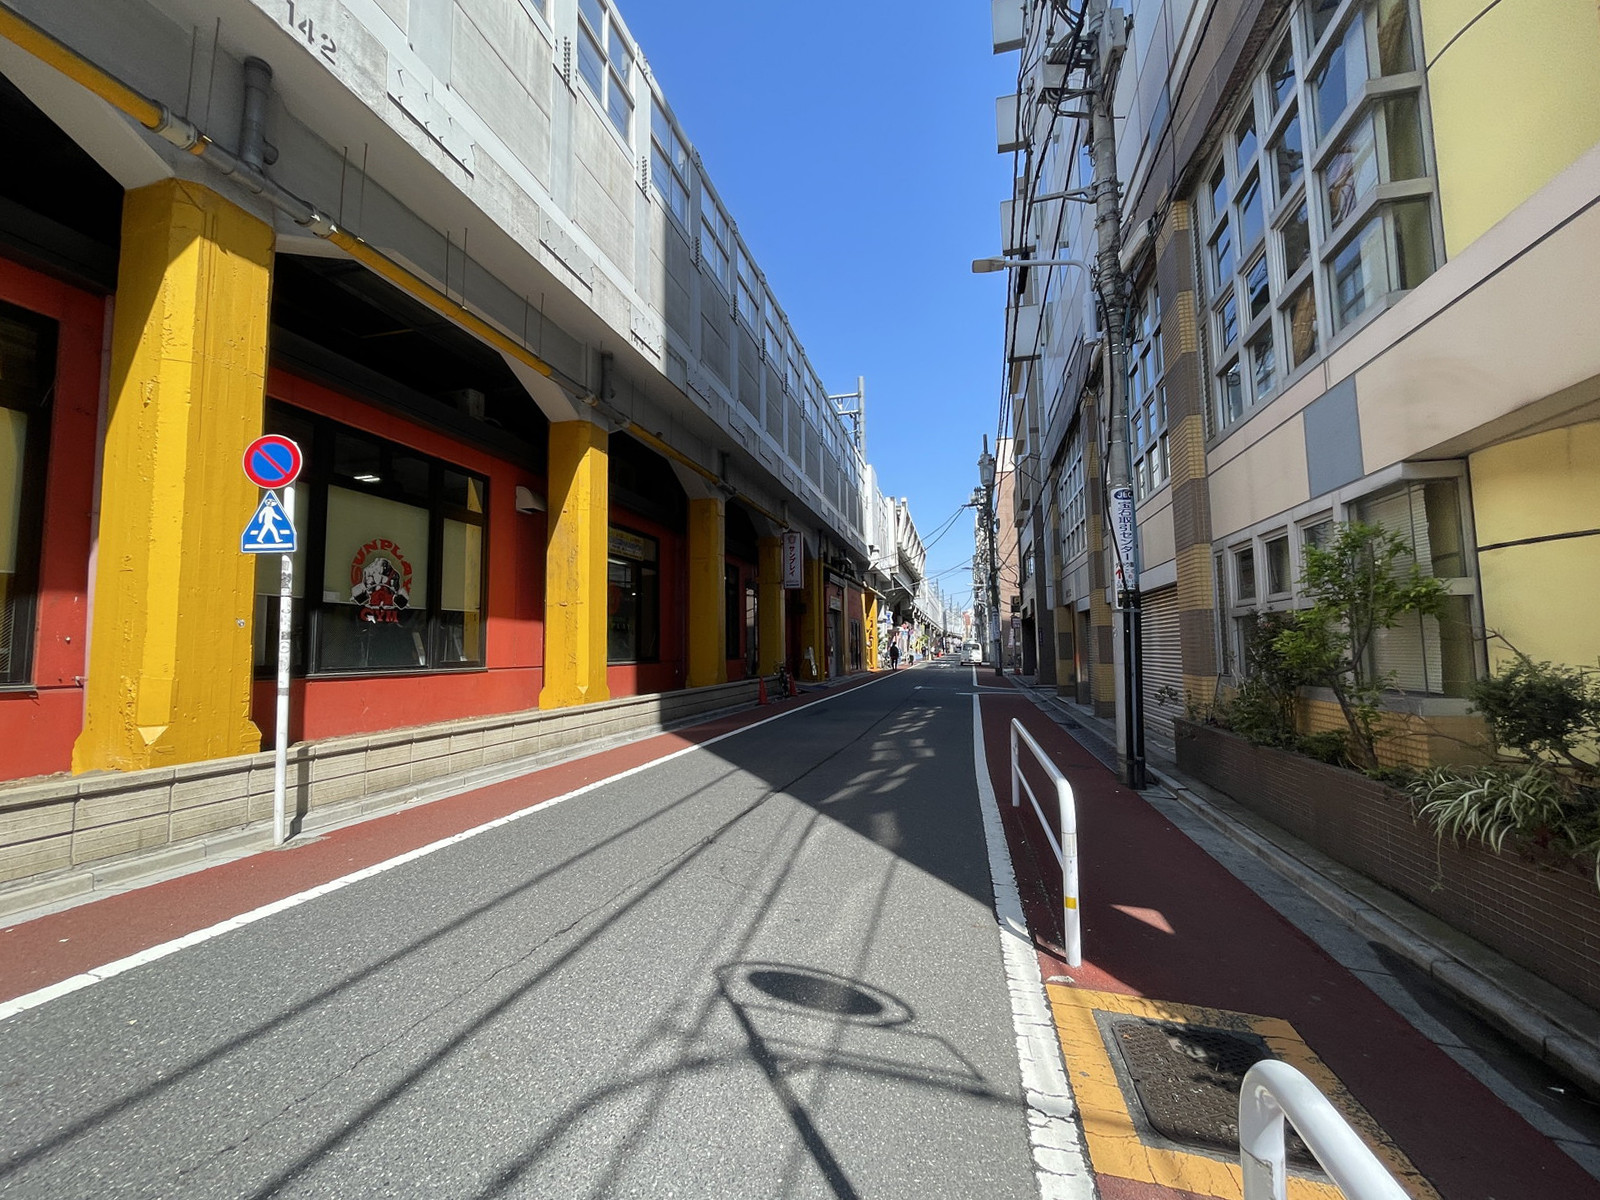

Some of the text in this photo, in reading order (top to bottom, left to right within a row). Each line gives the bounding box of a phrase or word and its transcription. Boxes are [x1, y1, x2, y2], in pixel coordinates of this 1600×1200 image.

[286, 0, 337, 66] 142
[1118, 501, 1133, 561] 宝石取引センター
[350, 538, 413, 596] SUNPLAY
[788, 545, 797, 577] サンプレイ
[359, 606, 400, 623] GYM
